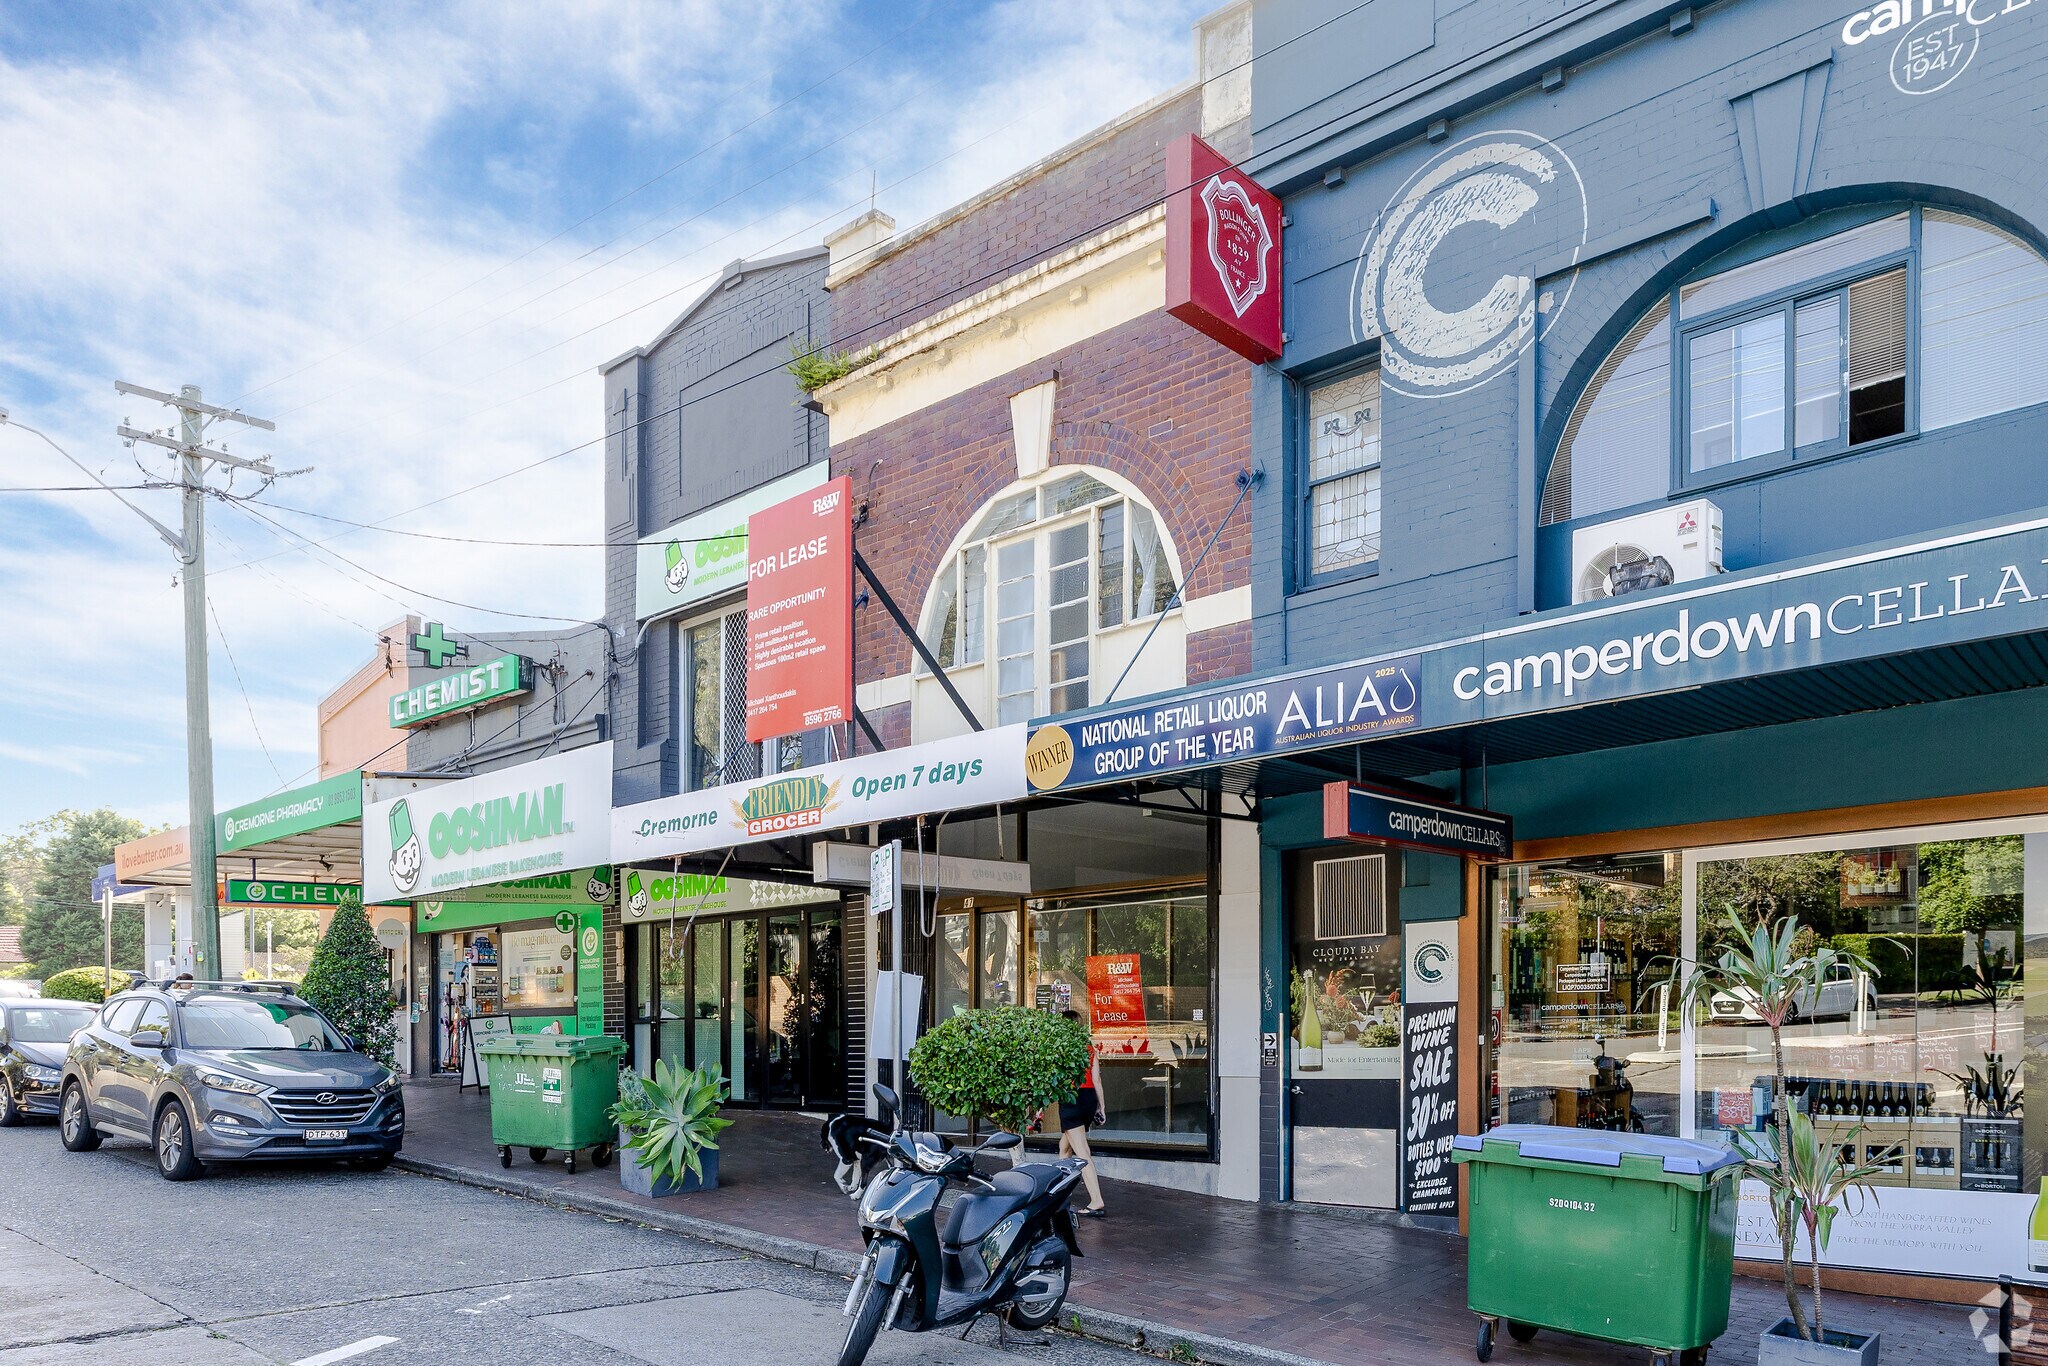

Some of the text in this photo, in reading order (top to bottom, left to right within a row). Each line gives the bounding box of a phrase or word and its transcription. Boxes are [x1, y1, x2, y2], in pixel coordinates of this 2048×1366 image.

[1907, 22, 1960, 61] EST
[1903, 43, 1964, 83] 1947
[1220, 209, 1256, 242] BOLLINGER
[1227, 240, 1249, 262] 1829
[812, 491, 841, 514] R&W
[749, 536, 828, 581] FOR LEASE
[694, 570, 718, 585] MODERN
[748, 587, 826, 621] RARE OPPORTUNITY
[755, 620, 804, 641] Prime retail position
[755, 629, 808, 651] Suit multitude of uses
[1453, 565, 2048, 703] camperdownCELLA
[755, 637, 816, 661] Highly desirable location
[755, 658, 776, 671] Spacious
[795, 648, 808, 658] retail
[810, 644, 826, 655] space
[1375, 667, 1396, 678] 2025
[394, 661, 504, 721] CHEMIST
[805, 714, 822, 726] 8596
[824, 709, 842, 721] 2766
[1276, 675, 1387, 735] ALIA
[1082, 691, 1267, 748] NATIONAL RETAIL LIQUOR
[1275, 715, 1415, 745] AUSTRALIAN LIQUOR INDUSTRY AWARDS
[1028, 741, 1070, 775] WINNER
[1095, 727, 1254, 775] GROUP OF THE YEAR
[852, 758, 983, 800] Open 7 days
[748, 774, 825, 819] FRIENDLY
[235, 796, 324, 833] CREMORNE PHARMACY
[429, 783, 564, 860] OOSHMAN
[641, 809, 718, 837] Cremorne
[749, 810, 820, 835] GROCER
[431, 851, 564, 888] MODERN LEBANESE BAKEHOUSE
[964, 898, 974, 908] 47
[1313, 945, 1381, 957] CLOUDY BAY
[1107, 962, 1133, 975] R&W
[1094, 993, 1113, 1005] For
[1097, 1010, 1128, 1022] Lease
[1407, 1006, 1456, 1034] PREMIUM
[1411, 1026, 1451, 1052] WINE
[1358, 1055, 1401, 1065] Entertaining
[1410, 1046, 1453, 1091] SALE
[1407, 1093, 1456, 1141] 30% OFF
[1408, 1135, 1454, 1161] BOTTLES OVER
[1412, 1186, 1452, 1199] CHAMPAGNE
[1409, 1201, 1455, 1212] CONDITIONS APPLY
[1881, 1212, 1992, 1226] HANDCRAFTED WINES
[1850, 1220, 1975, 1234] FROM THE YARRA VALLEY
[1836, 1235, 1859, 1244] TAKE
[1862, 1237, 1880, 1245] THE
[1883, 1239, 1926, 1249] MEMORY
[1929, 1241, 1956, 1250] WITH
